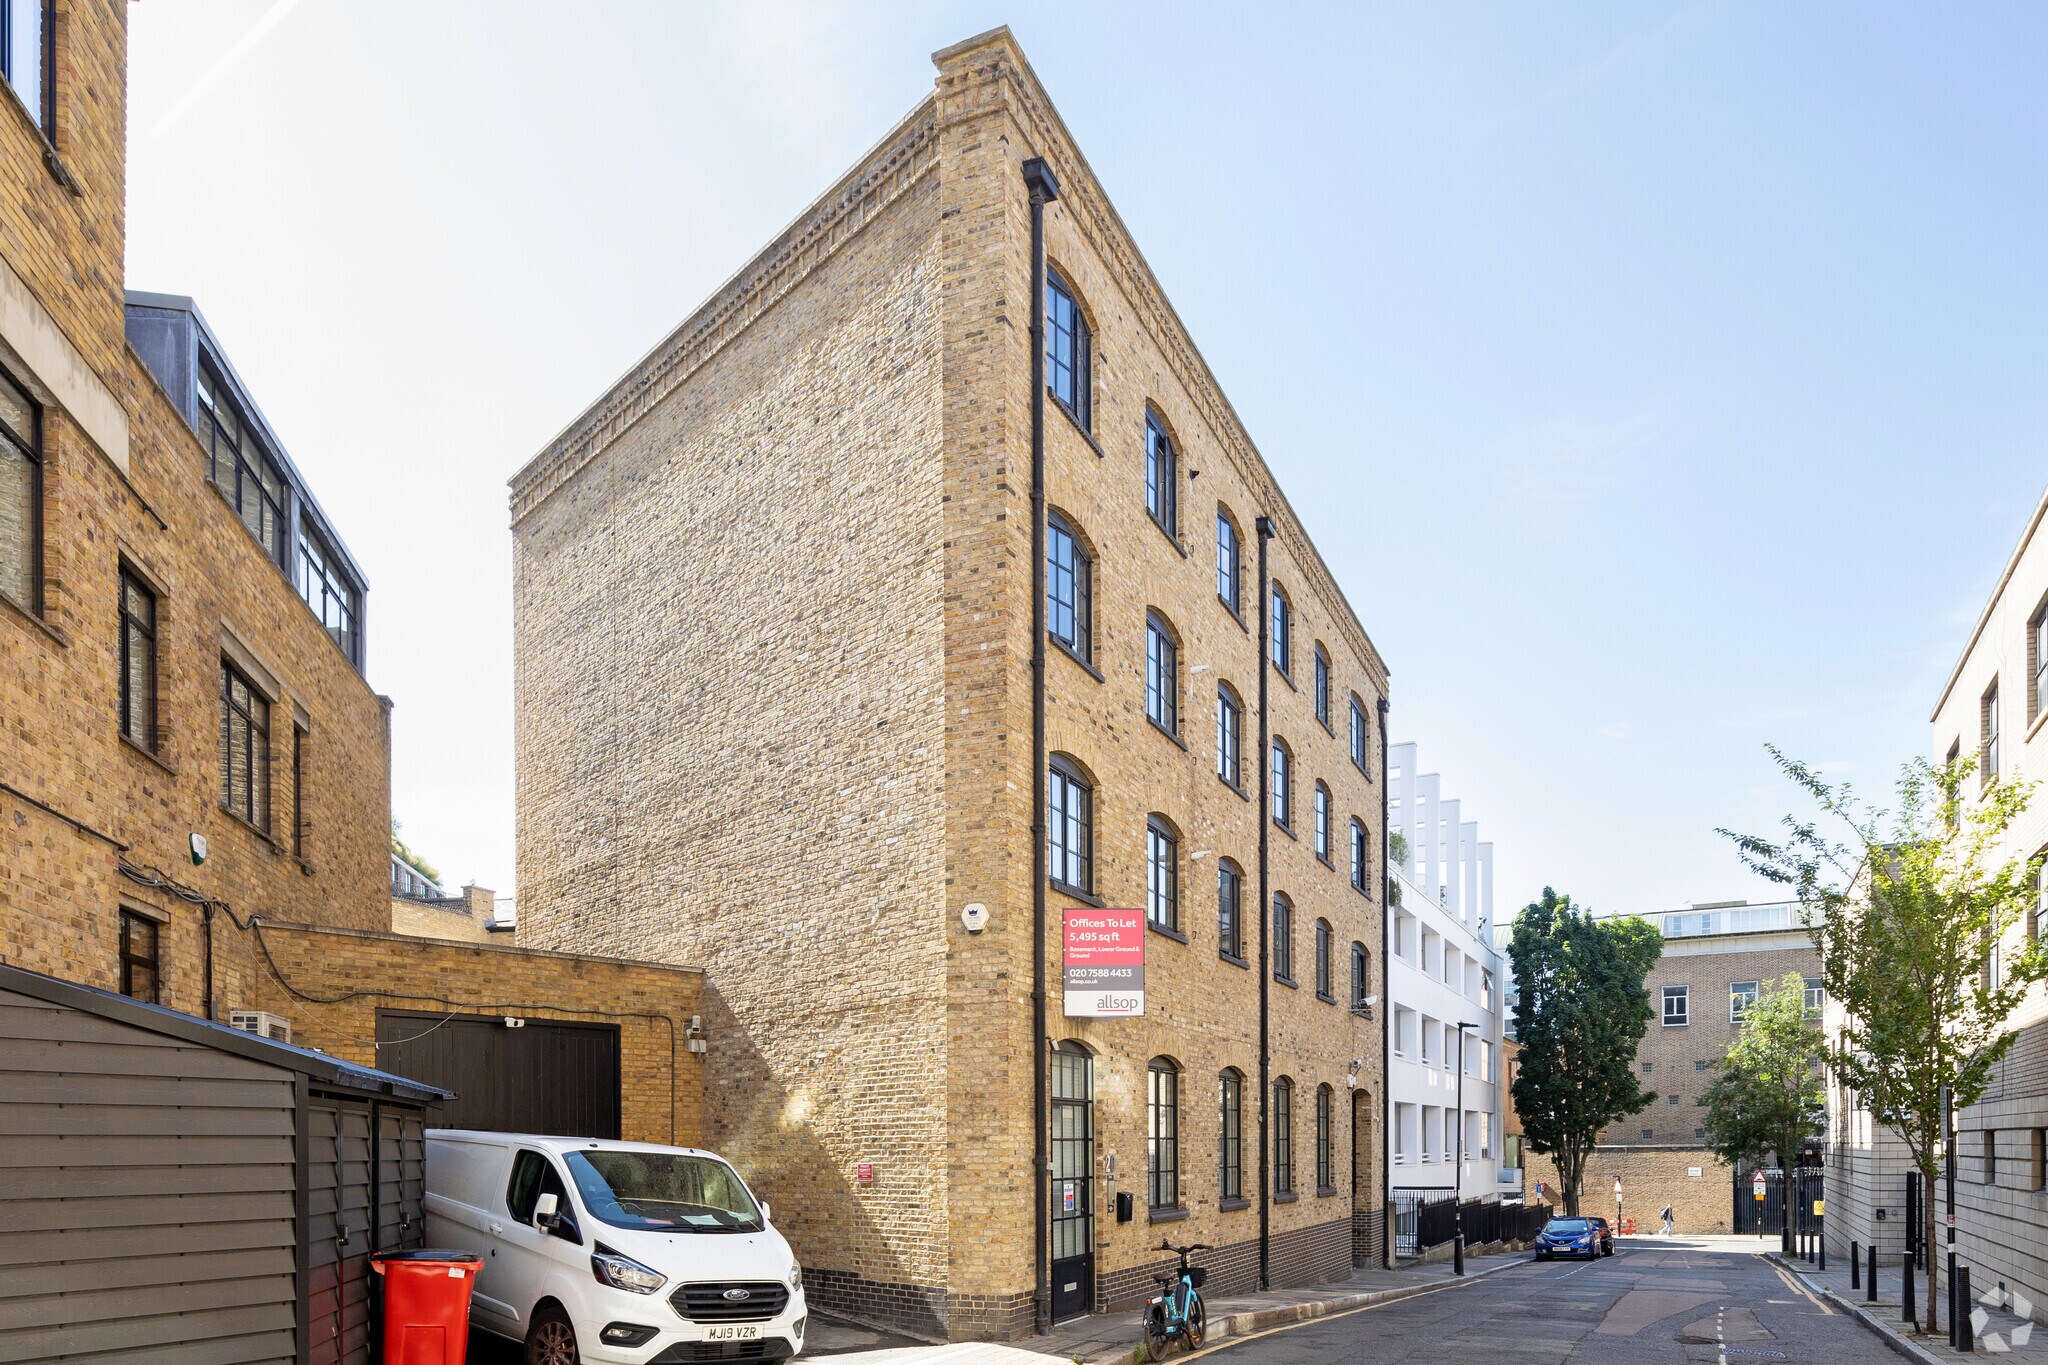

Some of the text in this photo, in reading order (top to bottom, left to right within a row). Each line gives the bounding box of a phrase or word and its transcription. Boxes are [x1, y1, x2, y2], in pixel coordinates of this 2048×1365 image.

[1069, 918, 1136, 928] Offices To Let
[1069, 932, 1120, 943] 5,495 sq ft
[1069, 968, 1132, 977] 020 7588 4433
[1097, 994, 1138, 1011] allsop
[708, 1326, 757, 1339] MJ19 VZR
